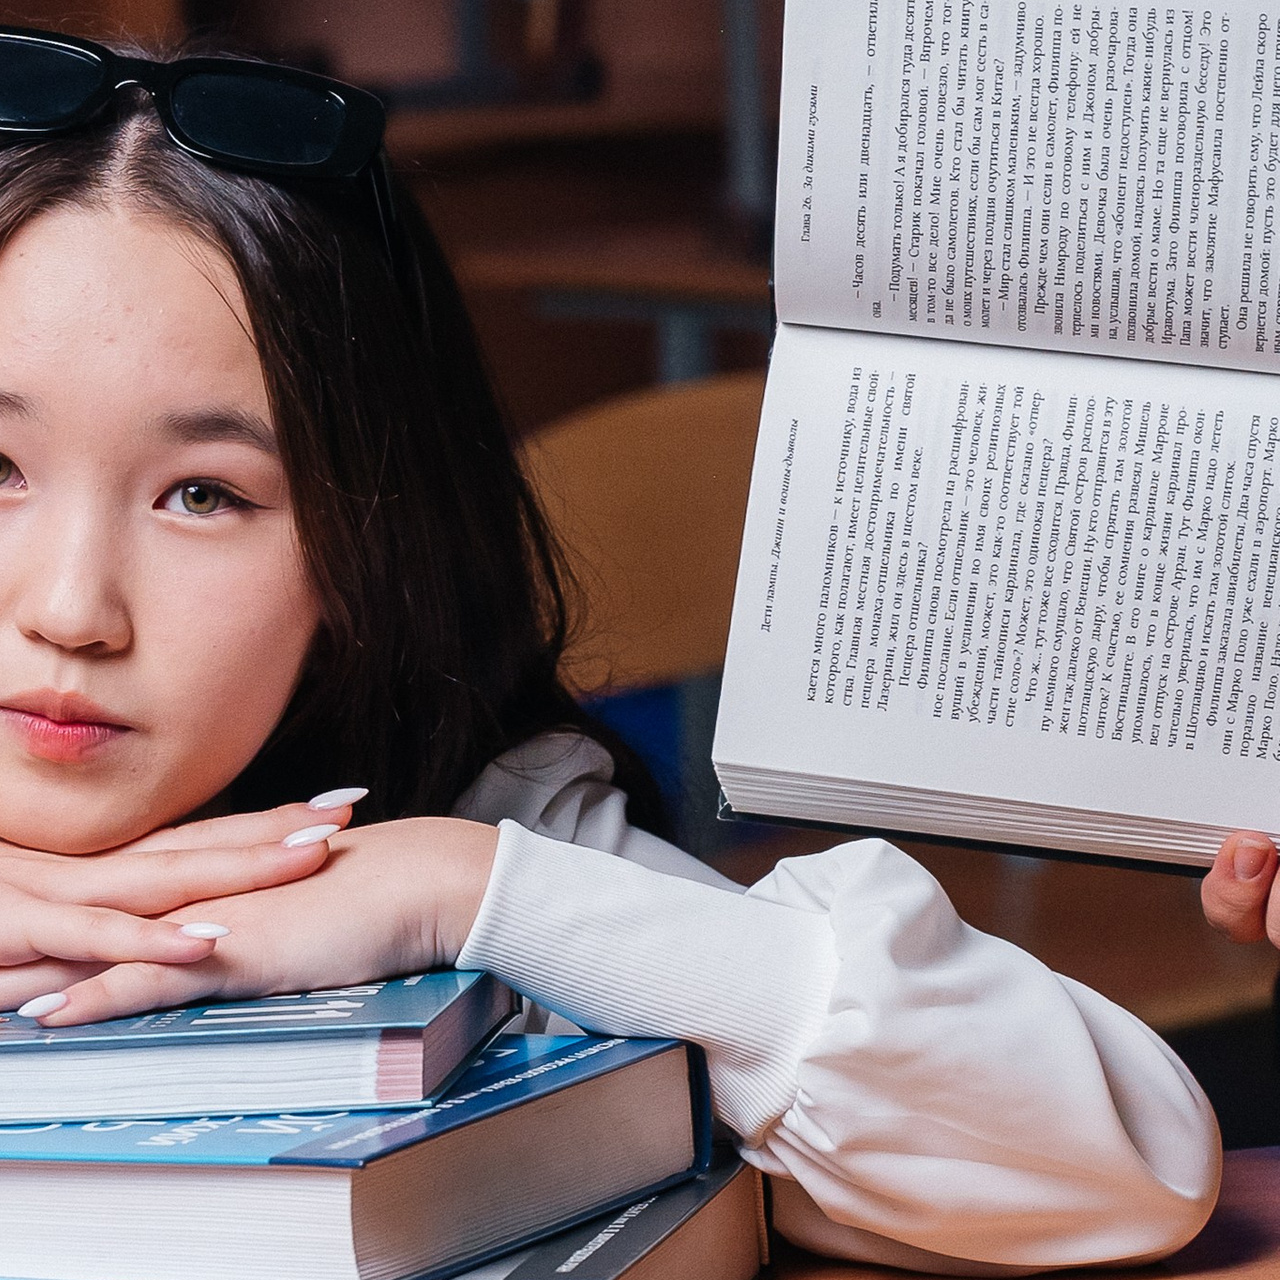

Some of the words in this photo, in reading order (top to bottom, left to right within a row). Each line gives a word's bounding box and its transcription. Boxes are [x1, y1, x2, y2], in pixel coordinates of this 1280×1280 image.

[1053, 3, 1063, 26] по-
[1046, 29, 1062, 94] Филиппа
[808, 84, 819, 127] гусями
[1044, 96, 1059, 158] самолет,
[801, 128, 815, 173] дикими
[1043, 160, 1054, 169] в
[801, 194, 812, 210] 26.
[802, 174, 813, 190] За
[1042, 173, 1053, 205] сели
[800, 212, 811, 242] Глава
[1039, 208, 1051, 235] они
[1038, 237, 1049, 264] чем
[1033, 266, 1049, 314] Прежде
[1217, 303, 1231, 350] ступает.
[866, 369, 880, 403] свой-
[779, 417, 799, 505] воины-дьяволы
[852, 405, 874, 494] целительные
[777, 506, 786, 515] и
[846, 496, 861, 539] имеет
[770, 517, 785, 560] Джинн
[765, 561, 779, 603] лампы.
[836, 542, 856, 610] полагают,
[907, 540, 928, 631] отшельника?
[759, 604, 773, 633] Дети
[833, 612, 845, 636] как
[824, 638, 843, 704] которого,
[897, 633, 918, 687] Пещера
